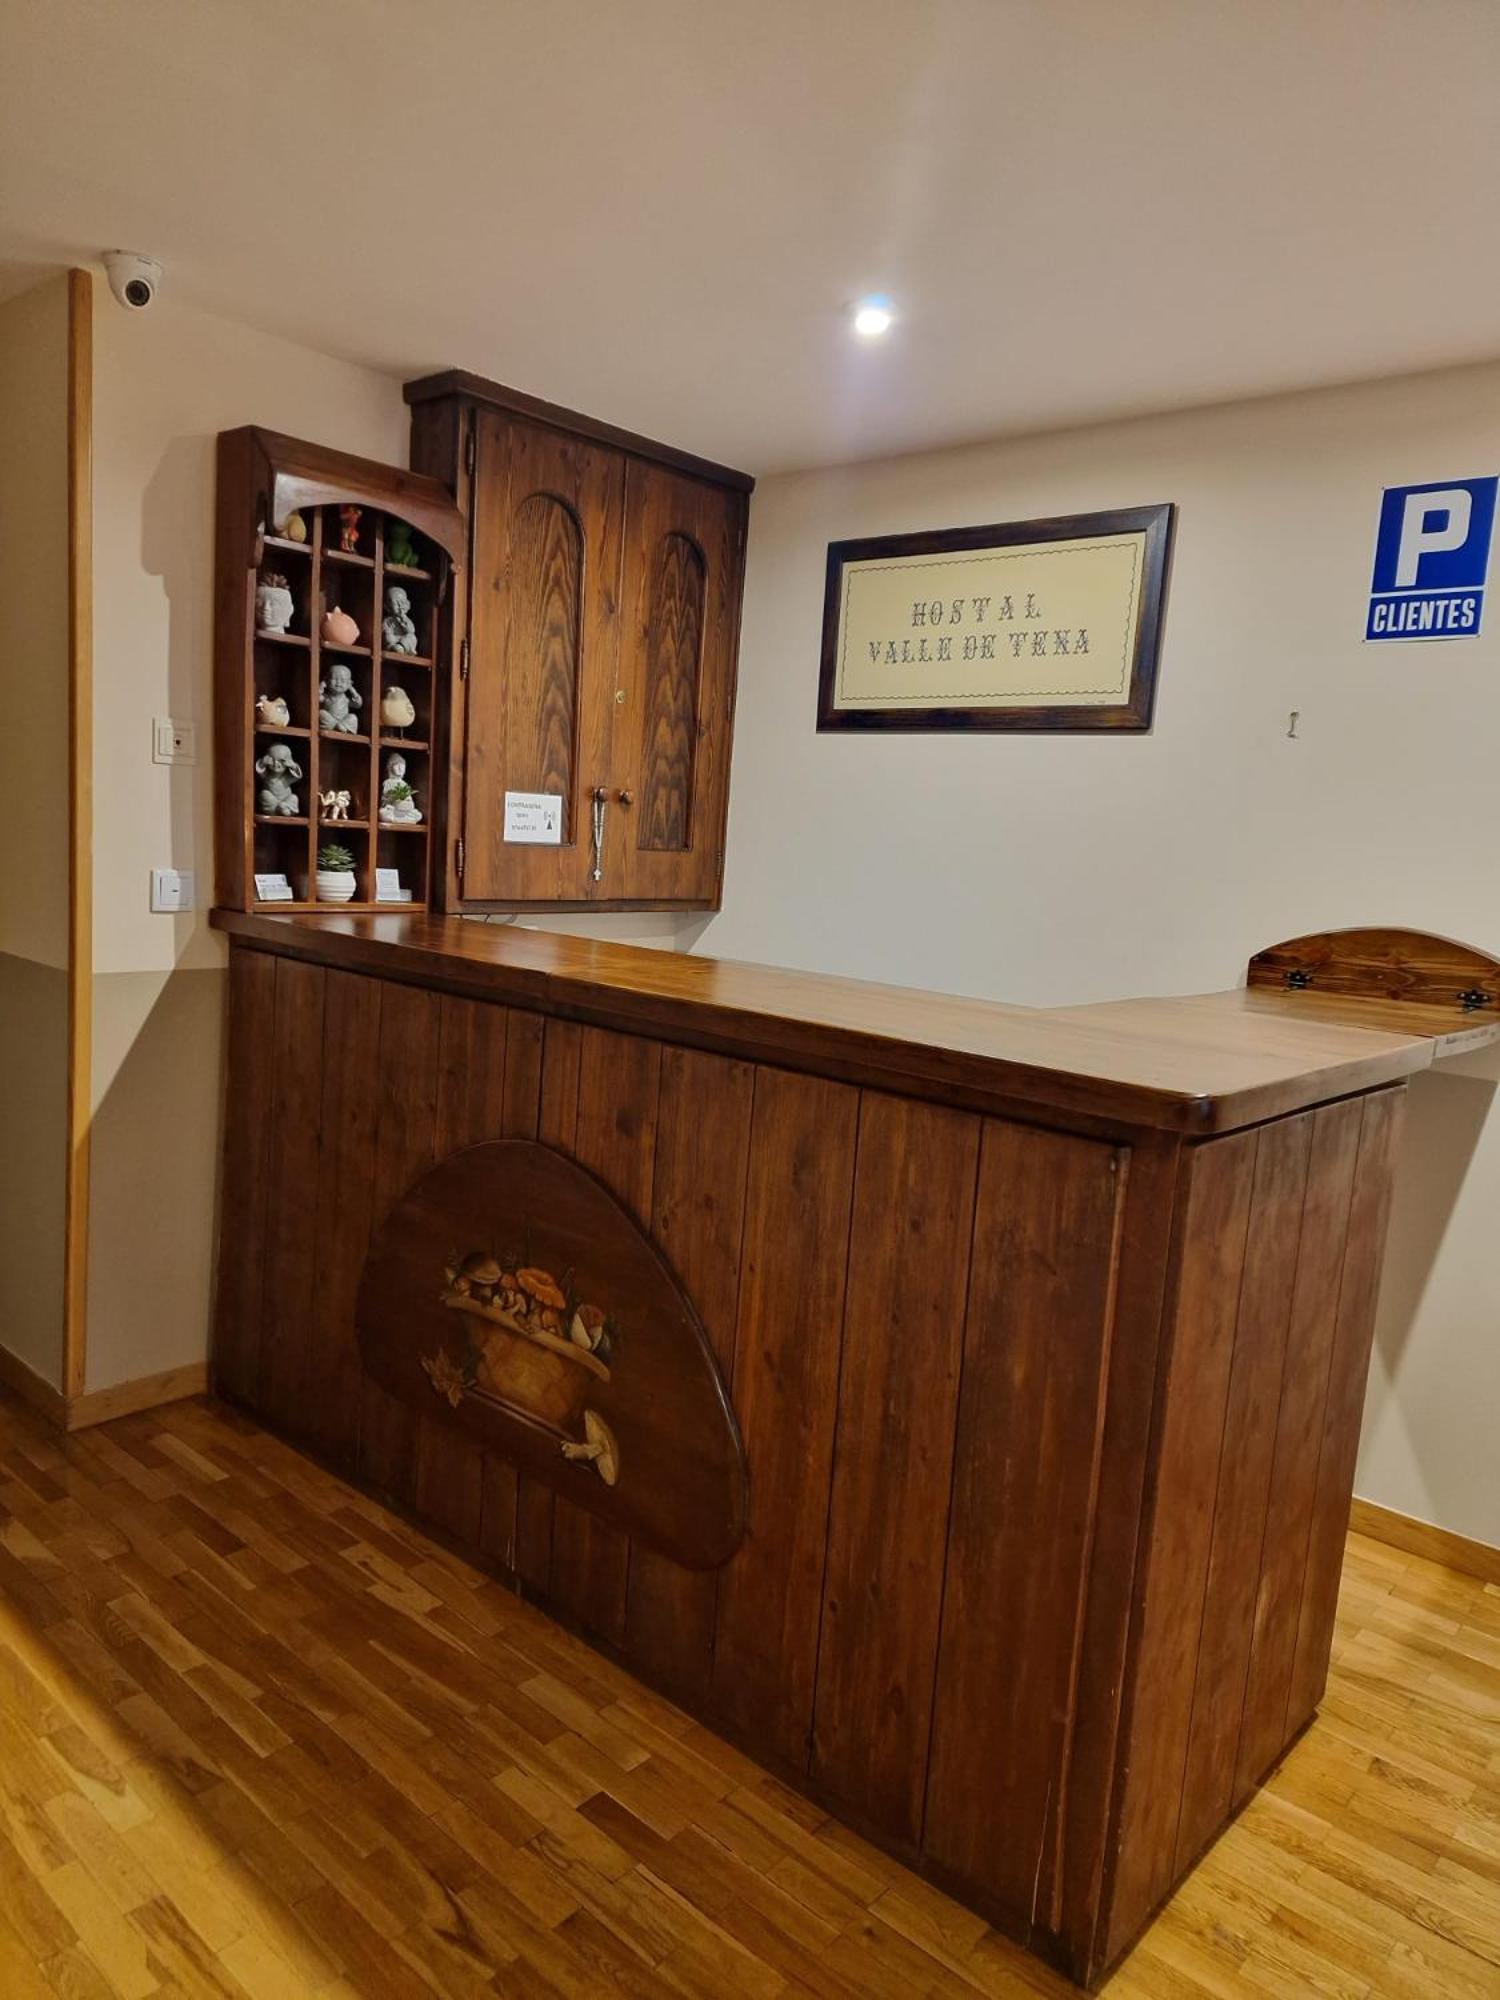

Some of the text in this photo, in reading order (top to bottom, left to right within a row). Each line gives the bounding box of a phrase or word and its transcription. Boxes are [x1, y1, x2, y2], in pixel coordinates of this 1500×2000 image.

[1395, 489, 1472, 587] P
[912, 593, 1041, 627] HOSTAL
[1373, 598, 1475, 633] CLIENTES
[869, 629, 1090, 664] VALLE DE TENA
